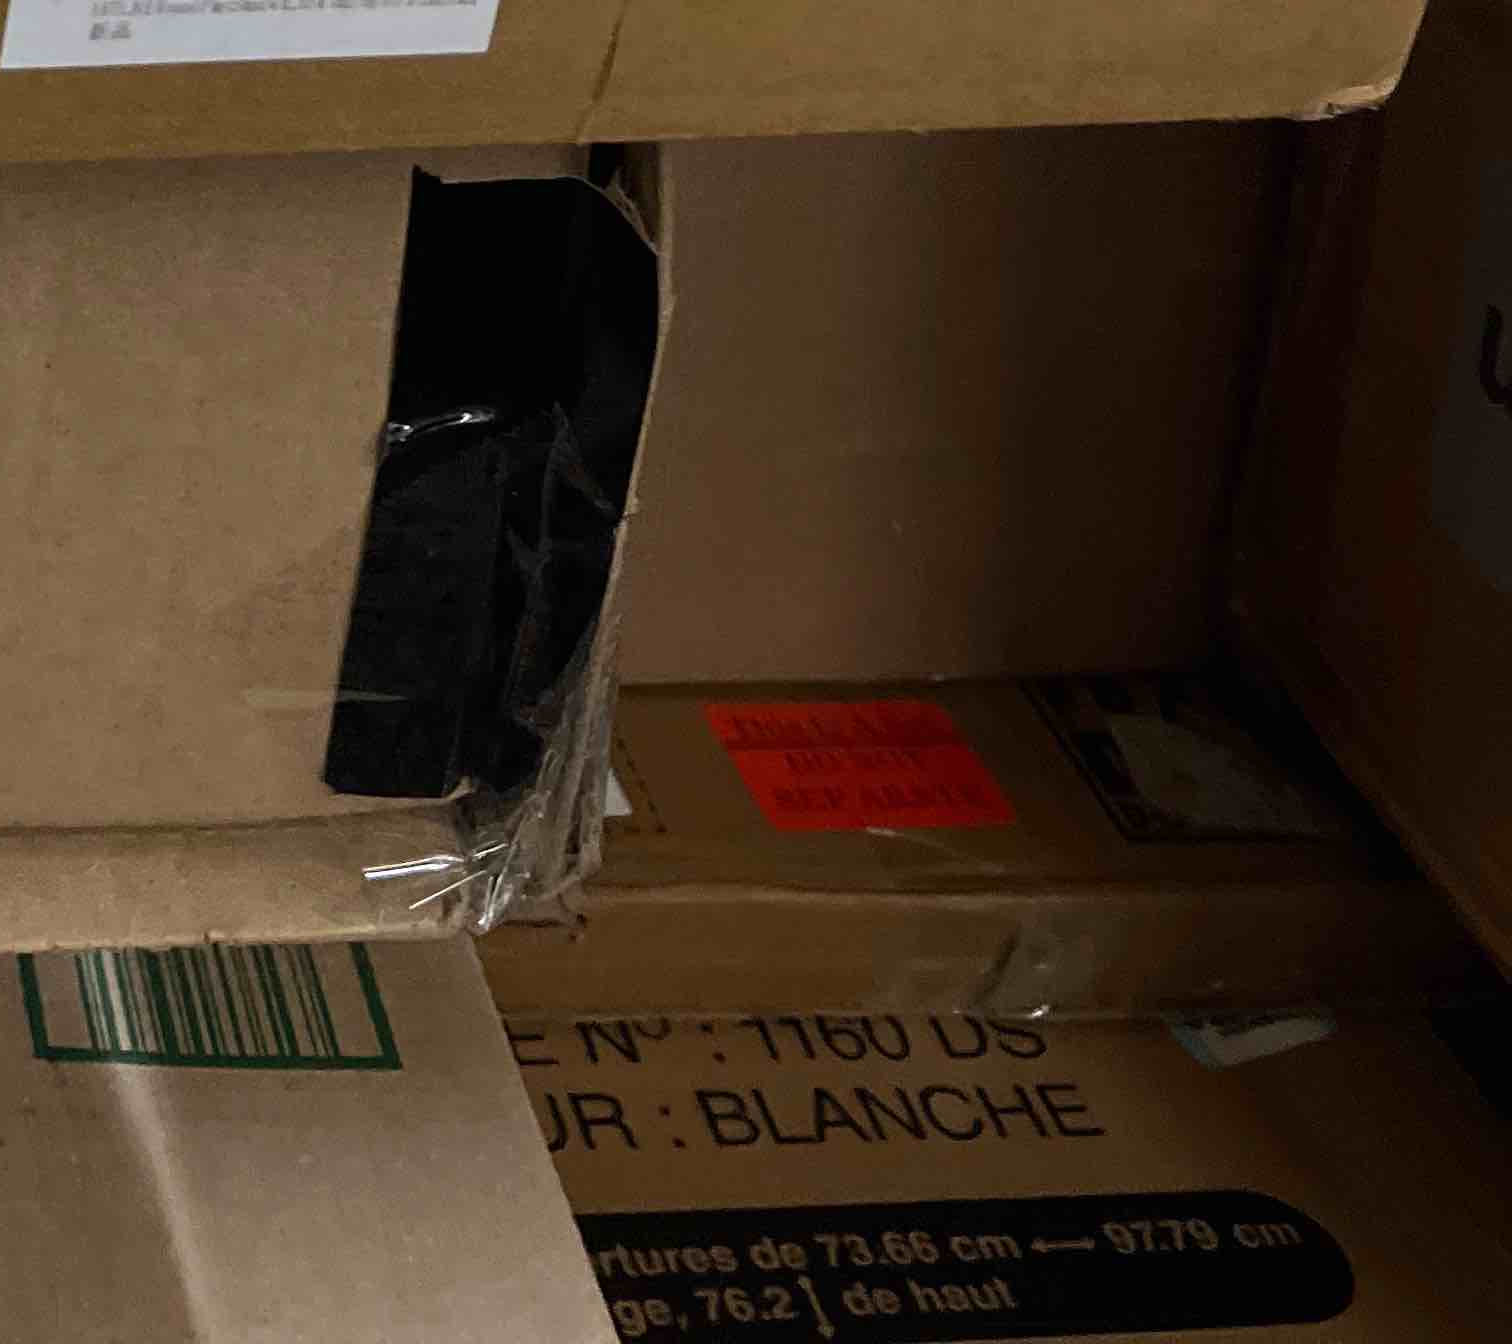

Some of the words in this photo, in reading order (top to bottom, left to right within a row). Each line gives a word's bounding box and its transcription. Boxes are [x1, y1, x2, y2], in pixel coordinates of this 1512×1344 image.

[695, 1083, 1106, 1147] BLANCHE
[750, 1235, 809, 1272] de
[811, 1231, 939, 1269] 73.66
[948, 1231, 1022, 1263] cm
[1100, 1218, 1221, 1255] 97.79
[1231, 1221, 1302, 1249] cm
[694, 1284, 799, 1326] 76.2
[841, 1277, 902, 1316] de
[909, 1275, 1019, 1314] haut
